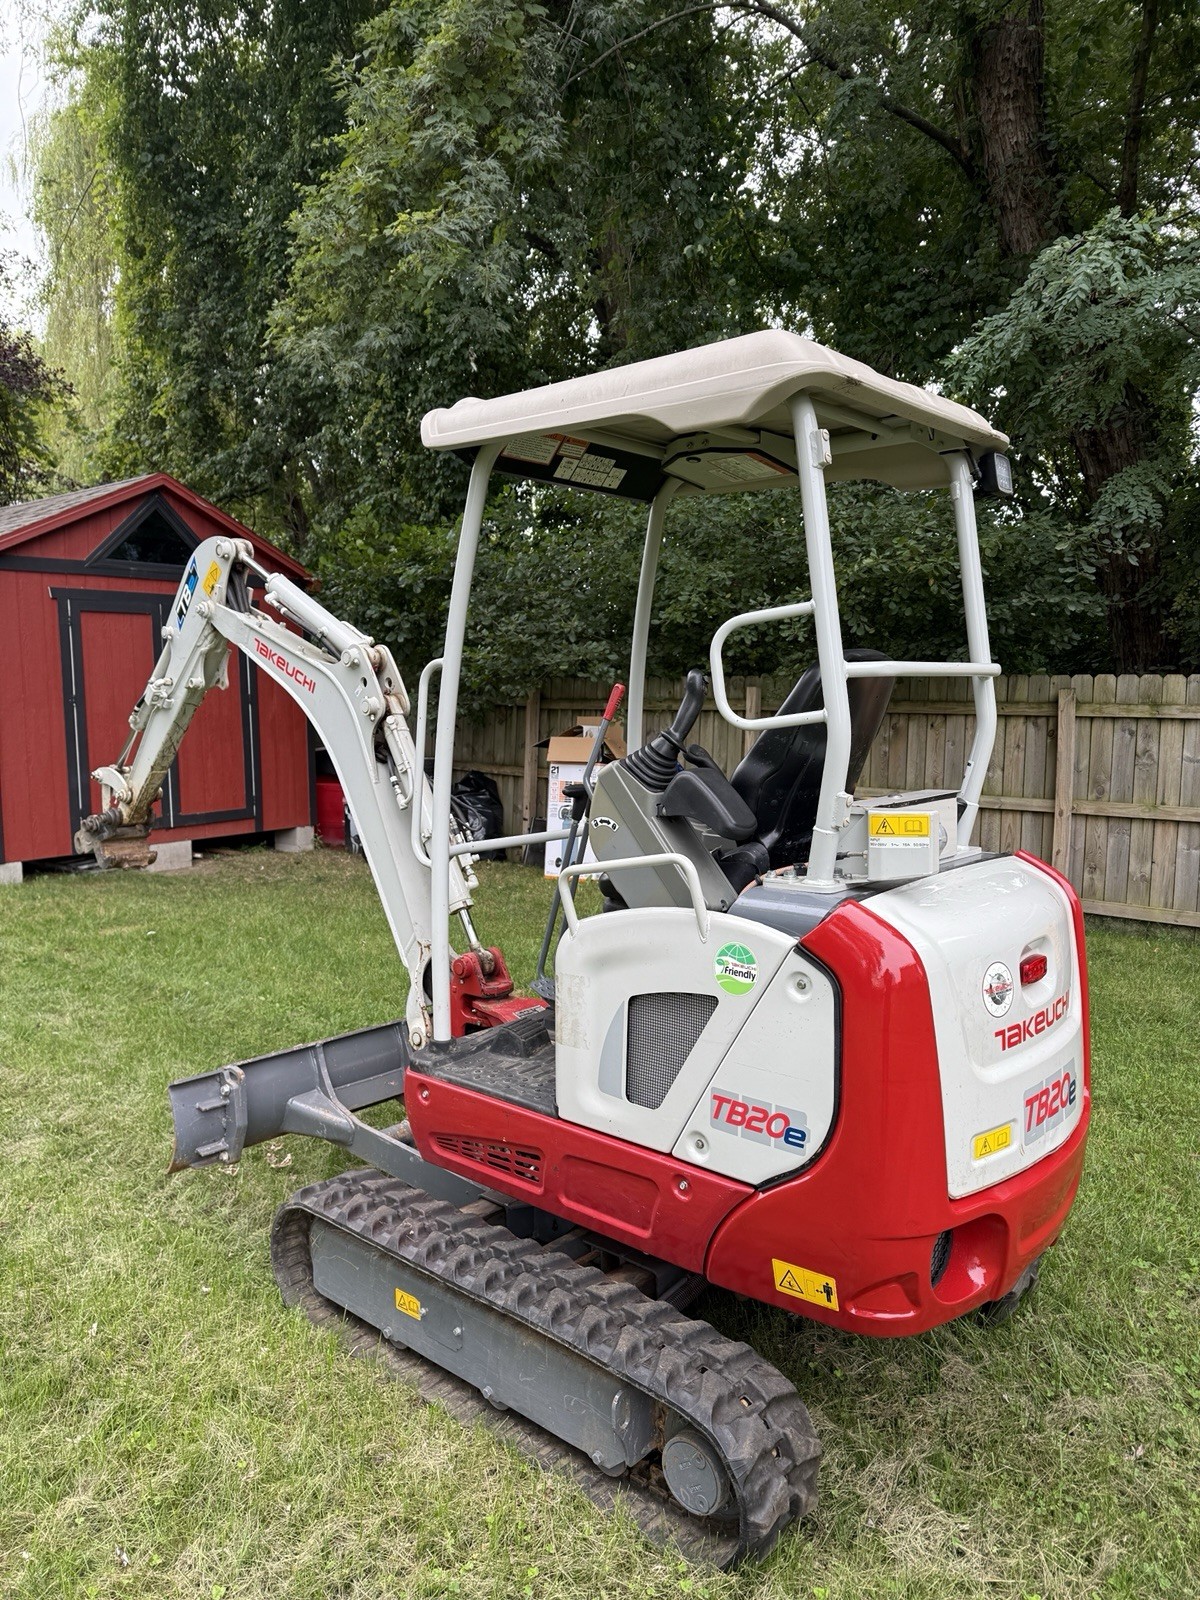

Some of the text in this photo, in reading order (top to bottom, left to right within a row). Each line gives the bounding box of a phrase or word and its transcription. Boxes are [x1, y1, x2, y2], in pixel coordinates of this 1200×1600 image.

[551, 765, 560, 774] 21
[712, 1094, 807, 1149] TB20e
[1025, 1072, 1077, 1133] TB20e
